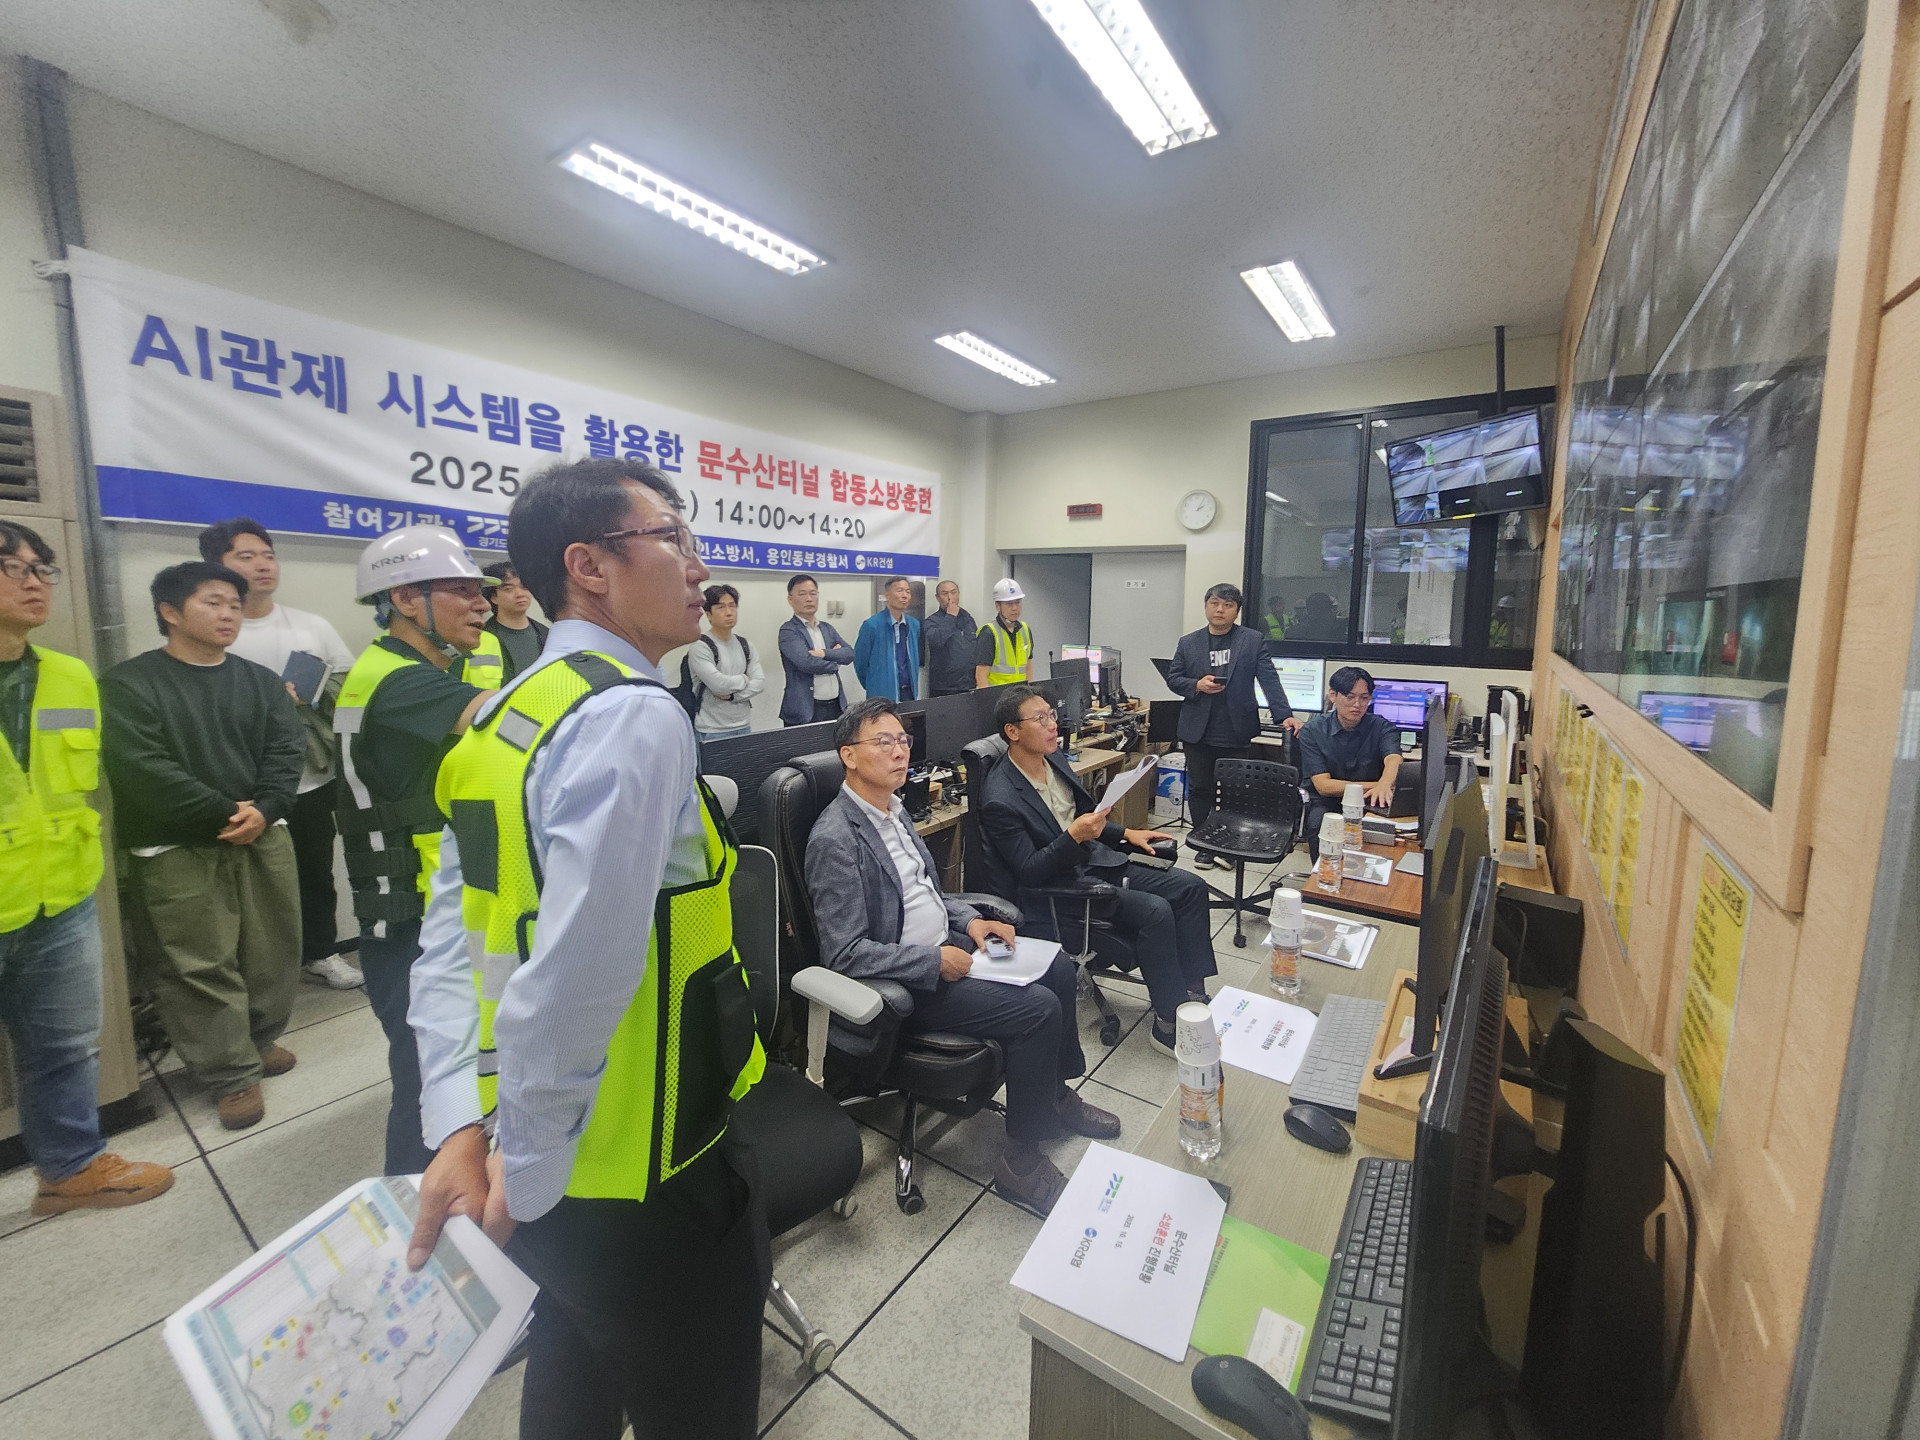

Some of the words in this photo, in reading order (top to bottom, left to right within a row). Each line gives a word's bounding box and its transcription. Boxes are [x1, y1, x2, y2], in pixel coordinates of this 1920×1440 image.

[129, 314, 348, 415] AI관제
[376, 370, 564, 455] 시스템을
[583, 414, 684, 473] 활용한
[697, 440, 820, 499] 문수산터널
[829, 468, 933, 516] 합동소방훈련
[714, 497, 866, 540] 14:00~14:20
[699, 541, 760, 565] 인소방서,
[766, 547, 849, 570] 용인동부경찰서
[866, 554, 894, 569] KR건설
[1152, 1212, 1174, 1247] 소방훈련
[1069, 1237, 1094, 1269] KR산업
[1138, 1246, 1162, 1285] 진행현황
[1163, 1229, 1188, 1276] 문수산터널
